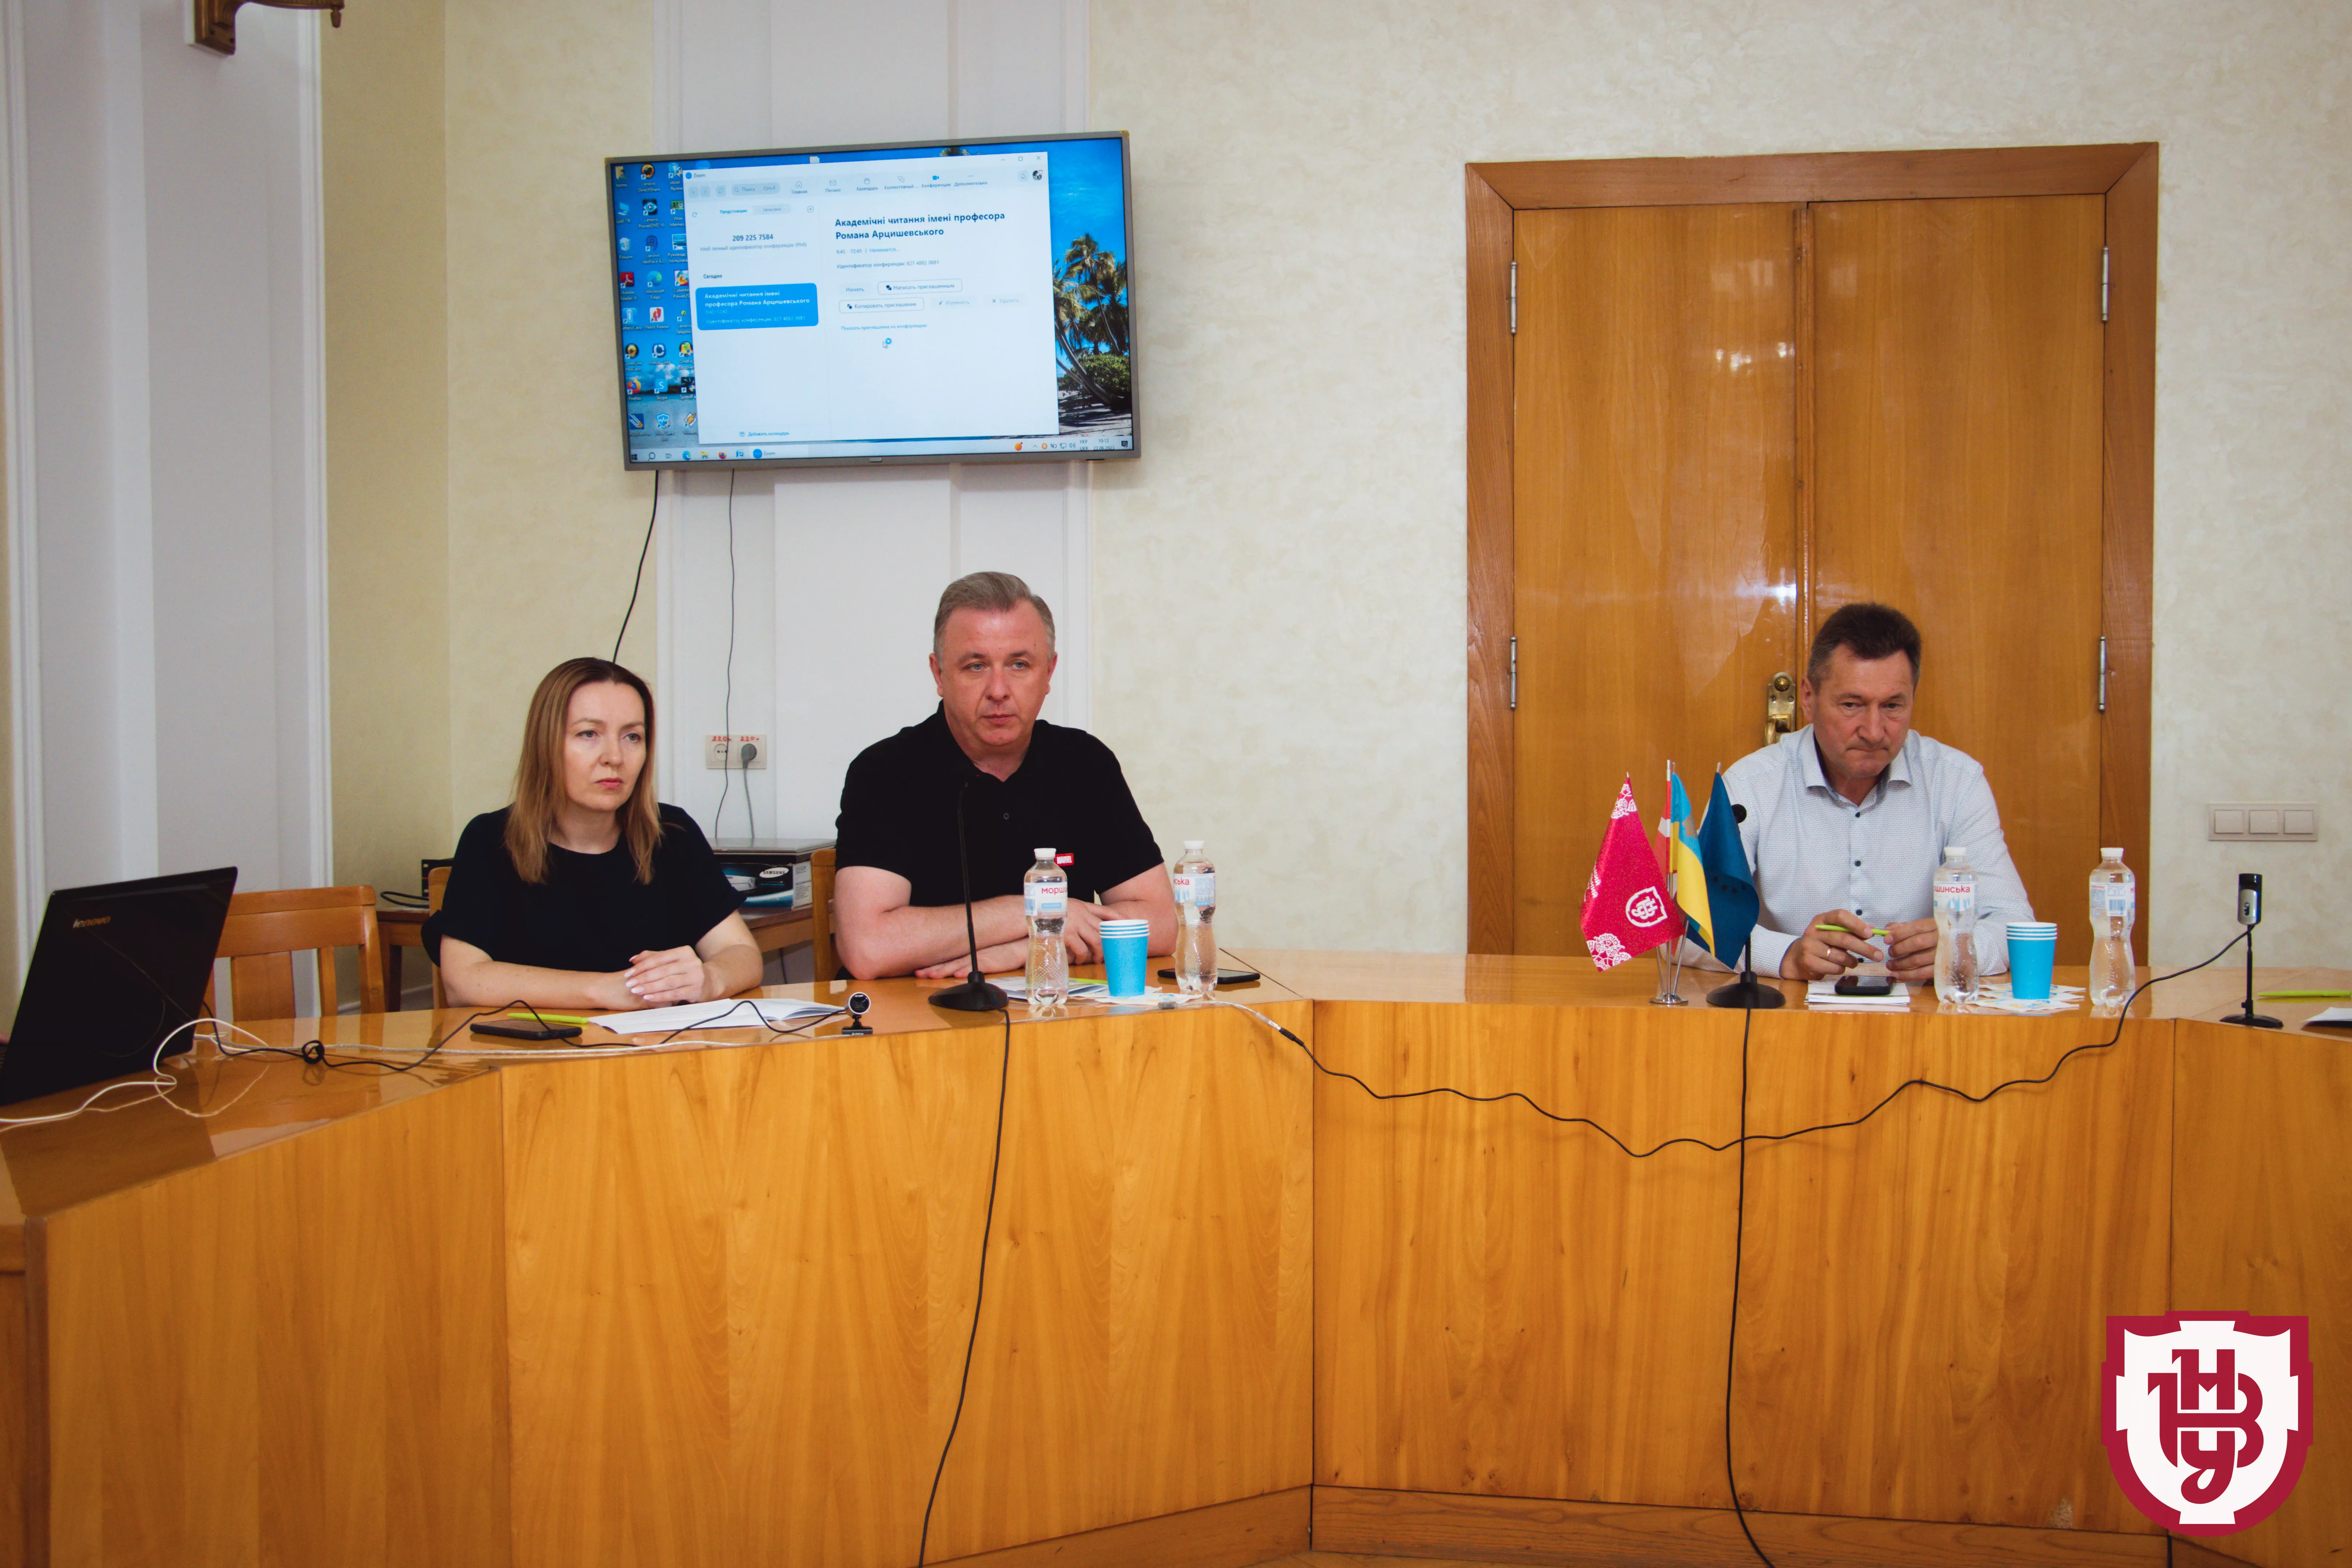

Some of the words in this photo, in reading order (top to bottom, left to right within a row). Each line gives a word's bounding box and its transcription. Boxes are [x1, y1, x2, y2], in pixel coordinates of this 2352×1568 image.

[835, 217, 885, 227] Академічні
[928, 214, 951, 222] імені
[954, 213, 1005, 223] професора
[836, 231, 869, 239] Романа
[872, 229, 944, 240] Арцишевського
[1056, 855, 1072, 864] MARVEL
